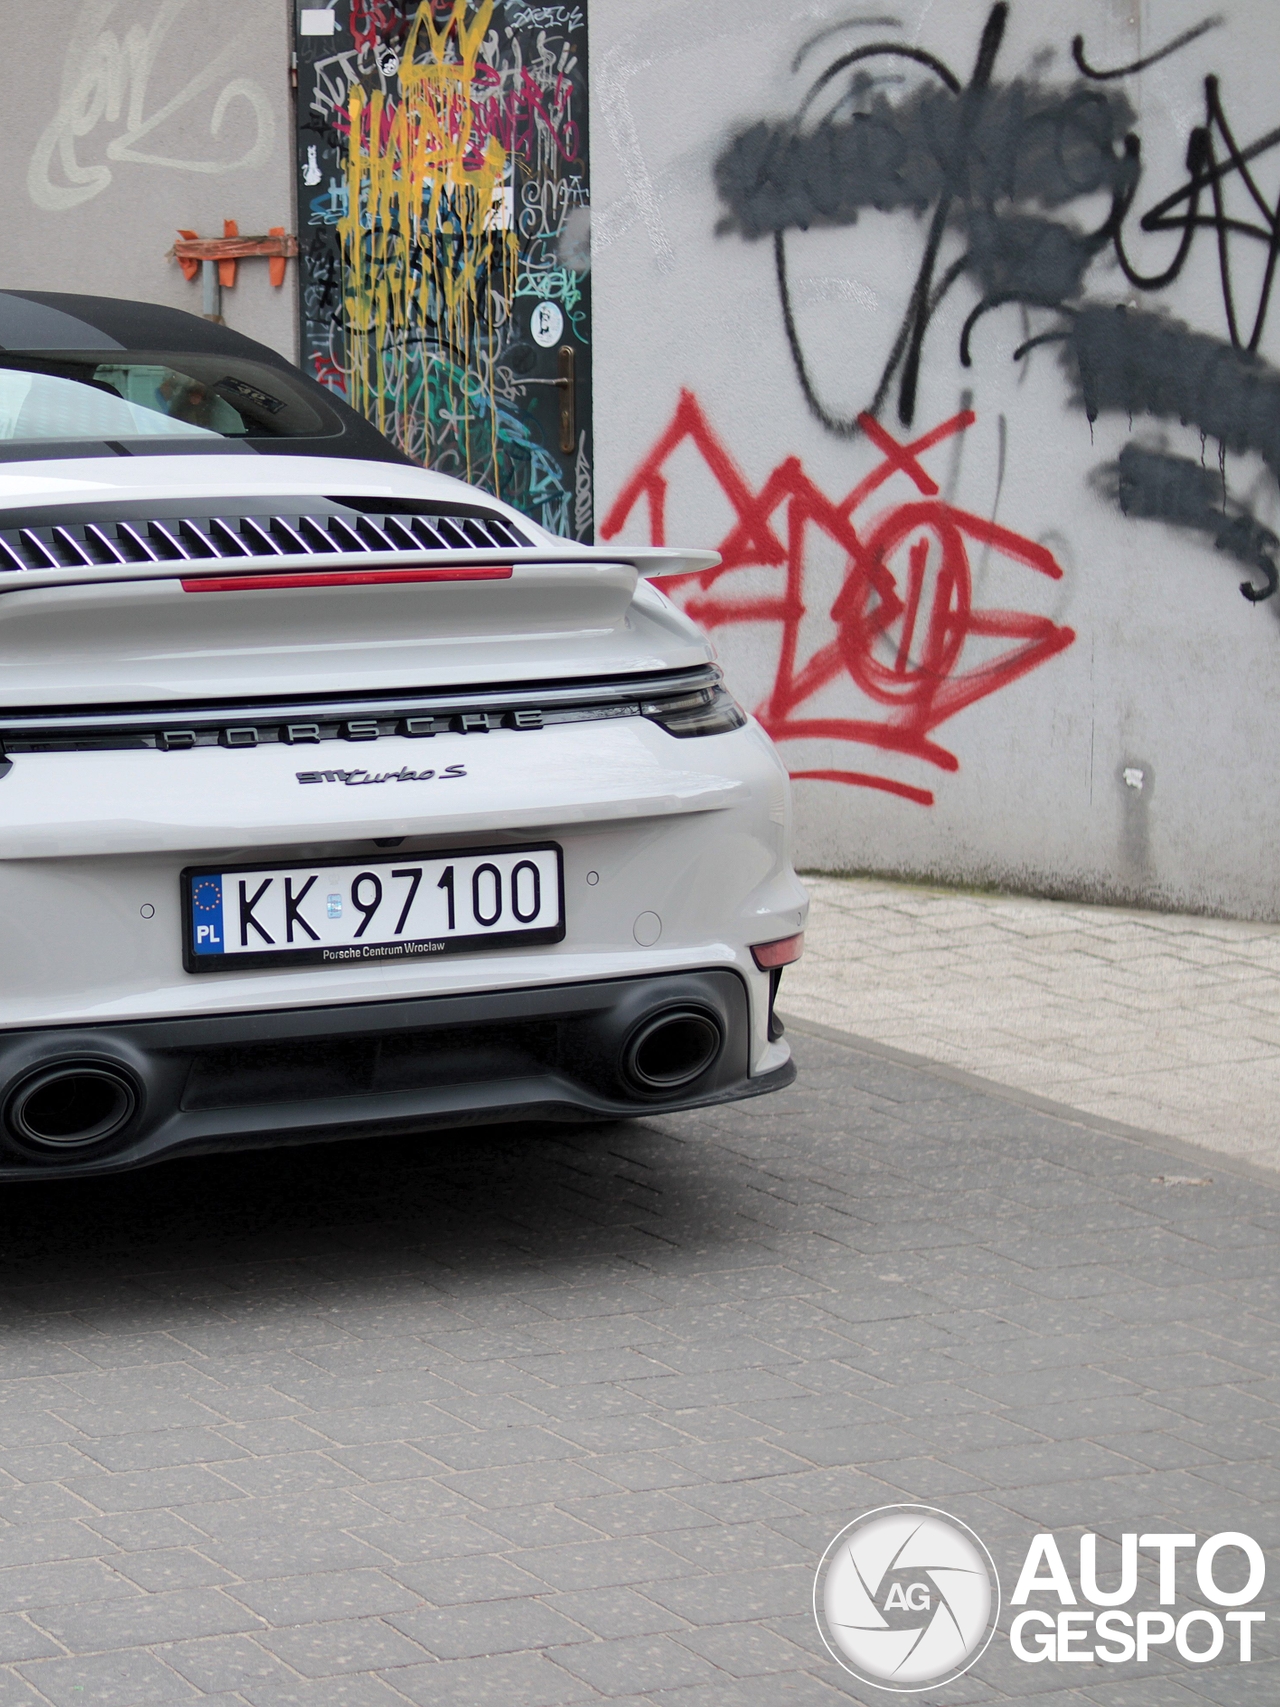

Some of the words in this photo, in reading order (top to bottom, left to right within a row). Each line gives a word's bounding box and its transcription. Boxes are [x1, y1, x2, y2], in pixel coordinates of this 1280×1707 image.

[159, 709, 544, 752] PORSCHE
[350, 859, 541, 938] 97100
[196, 925, 220, 944] PL
[323, 948, 361, 960] Porsche
[362, 945, 403, 957] Centrum
